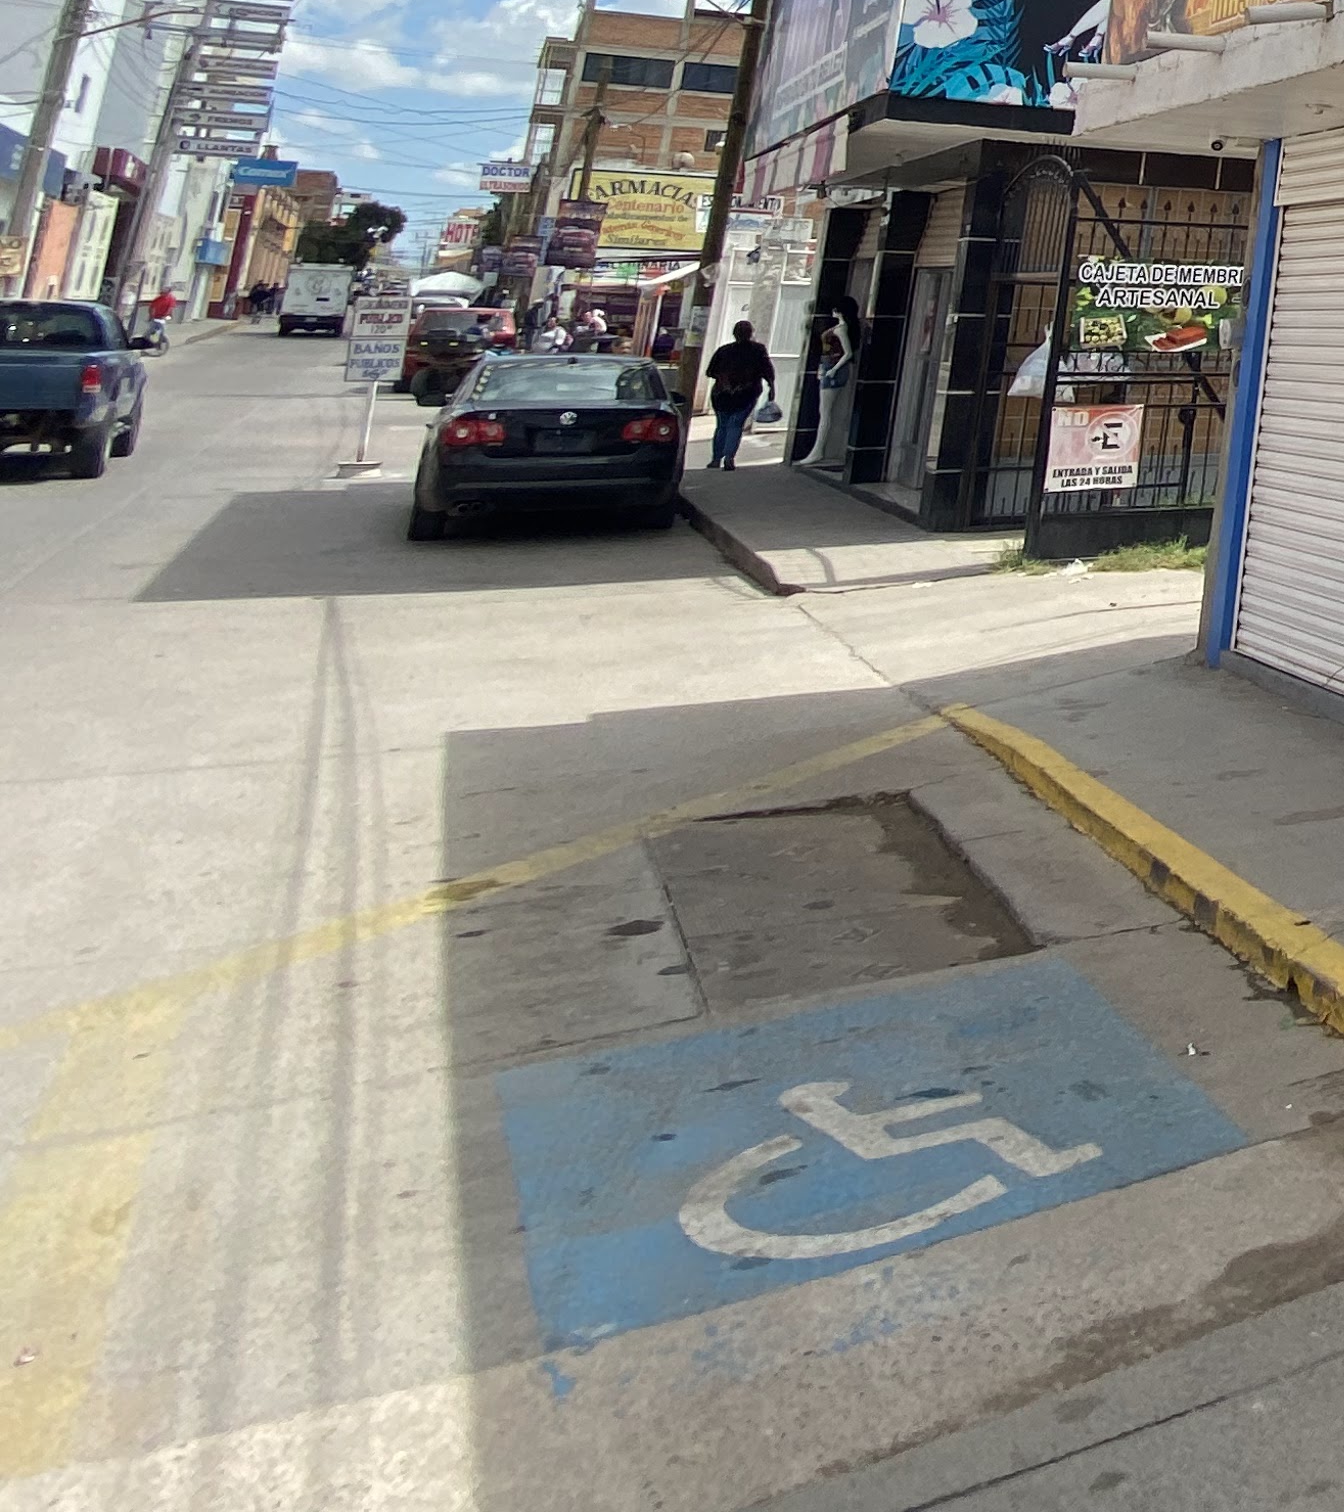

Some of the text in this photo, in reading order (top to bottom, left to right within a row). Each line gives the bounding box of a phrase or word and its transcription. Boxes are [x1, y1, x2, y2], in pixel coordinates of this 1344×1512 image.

[197, 143, 252, 153] LLANTAS
[482, 166, 529, 178] DOCTOR
[590, 179, 697, 211] ARMACIA
[606, 197, 685, 218] Centenario
[1080, 263, 1244, 286] CAJETA DE MEMBRI
[1097, 289, 1220, 308] ARTESANAL
[1052, 467, 1093, 479] ENTRADA
[1101, 465, 1133, 476] SALIDA
[1061, 475, 1123, 488] LAS 24 HORAS
